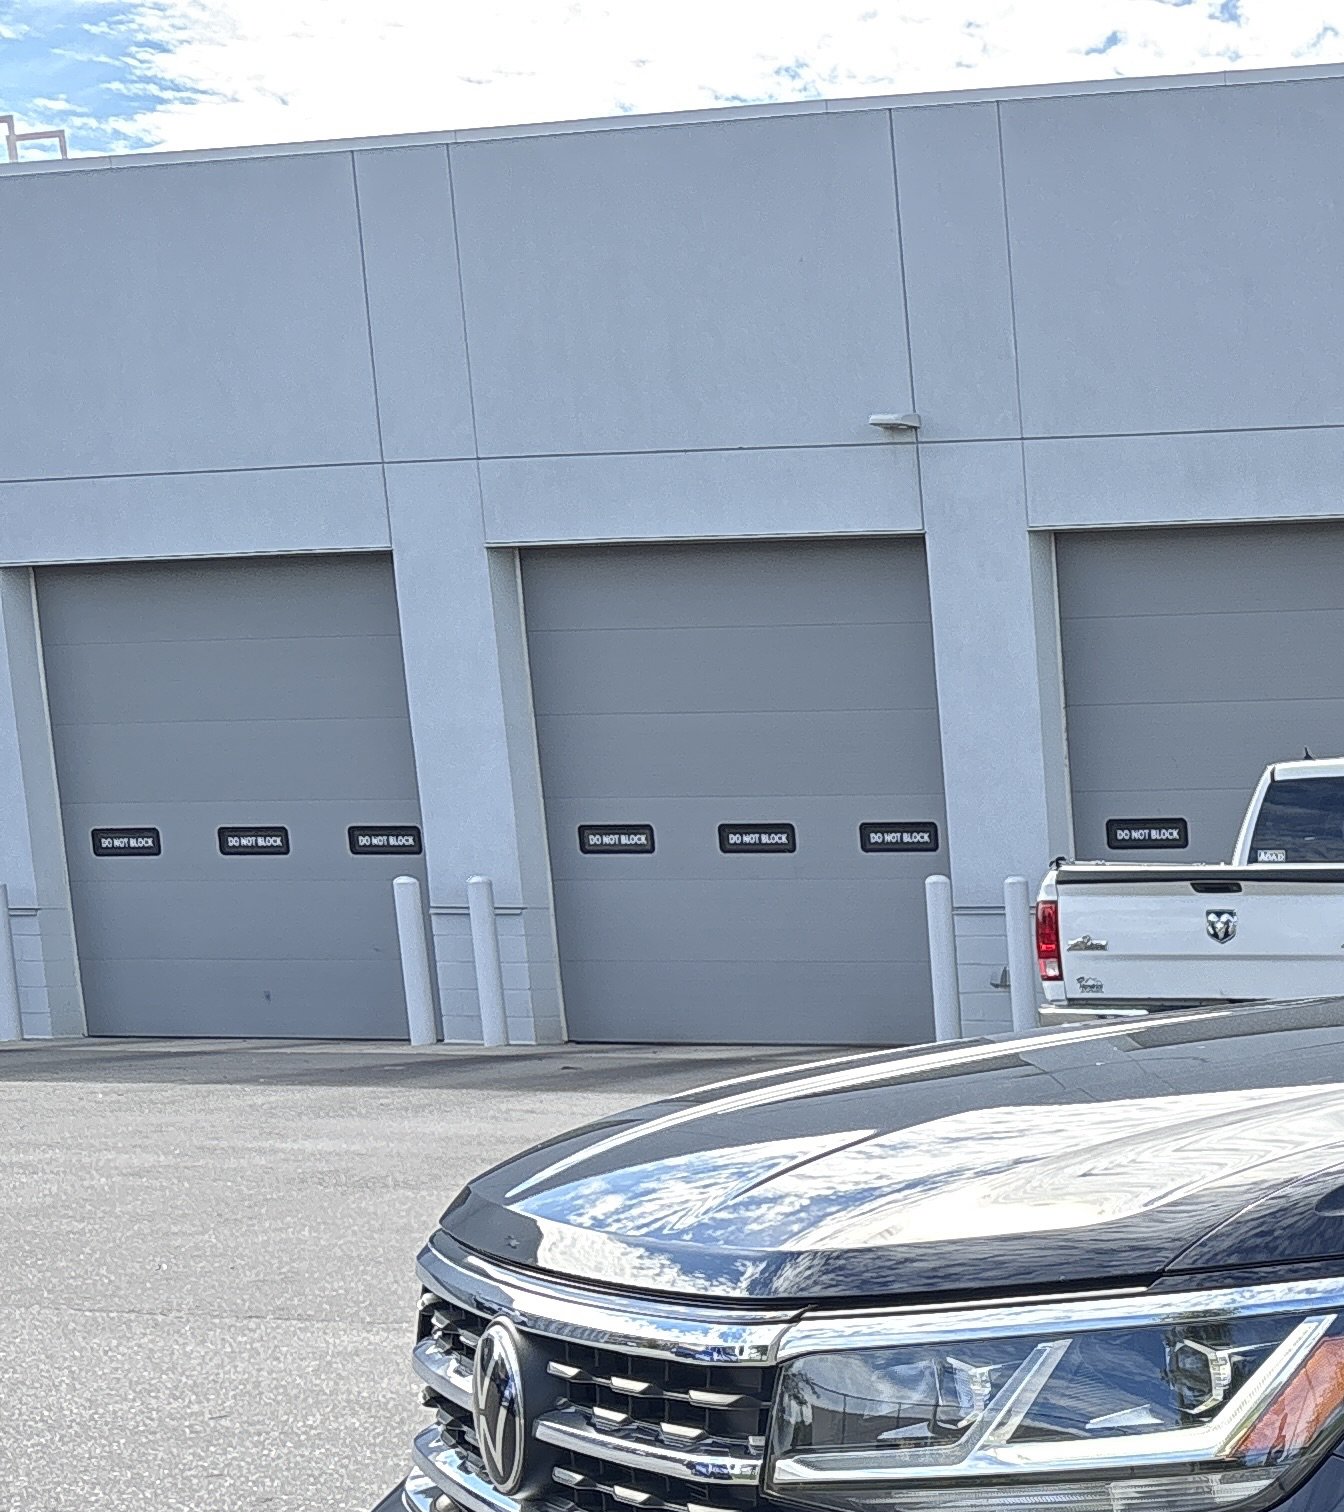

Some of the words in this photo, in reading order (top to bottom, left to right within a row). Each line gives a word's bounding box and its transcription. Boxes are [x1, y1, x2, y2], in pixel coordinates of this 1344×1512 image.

[588, 834, 601, 845] DO
[602, 834, 619, 845] NOT
[620, 834, 647, 845] BLOCK
[728, 833, 741, 844] DO
[742, 833, 760, 844] NOT
[761, 833, 789, 844] BLOCK
[869, 832, 883, 843] DO
[884, 832, 901, 843] NOT
[902, 832, 931, 843] BLOCK
[1116, 828, 1130, 840] DO
[1131, 828, 1149, 840] NOT
[1150, 828, 1180, 840] BLOCK
[101, 837, 113, 848] DO
[113, 837, 128, 848] NOT
[129, 837, 154, 848] BLOCK
[227, 836, 239, 847] DO
[240, 836, 256, 847] NOT
[257, 836, 283, 847] BLOCK
[358, 835, 371, 846] DO
[371, 835, 387, 846] NOT
[389, 835, 415, 846] BLOCK
